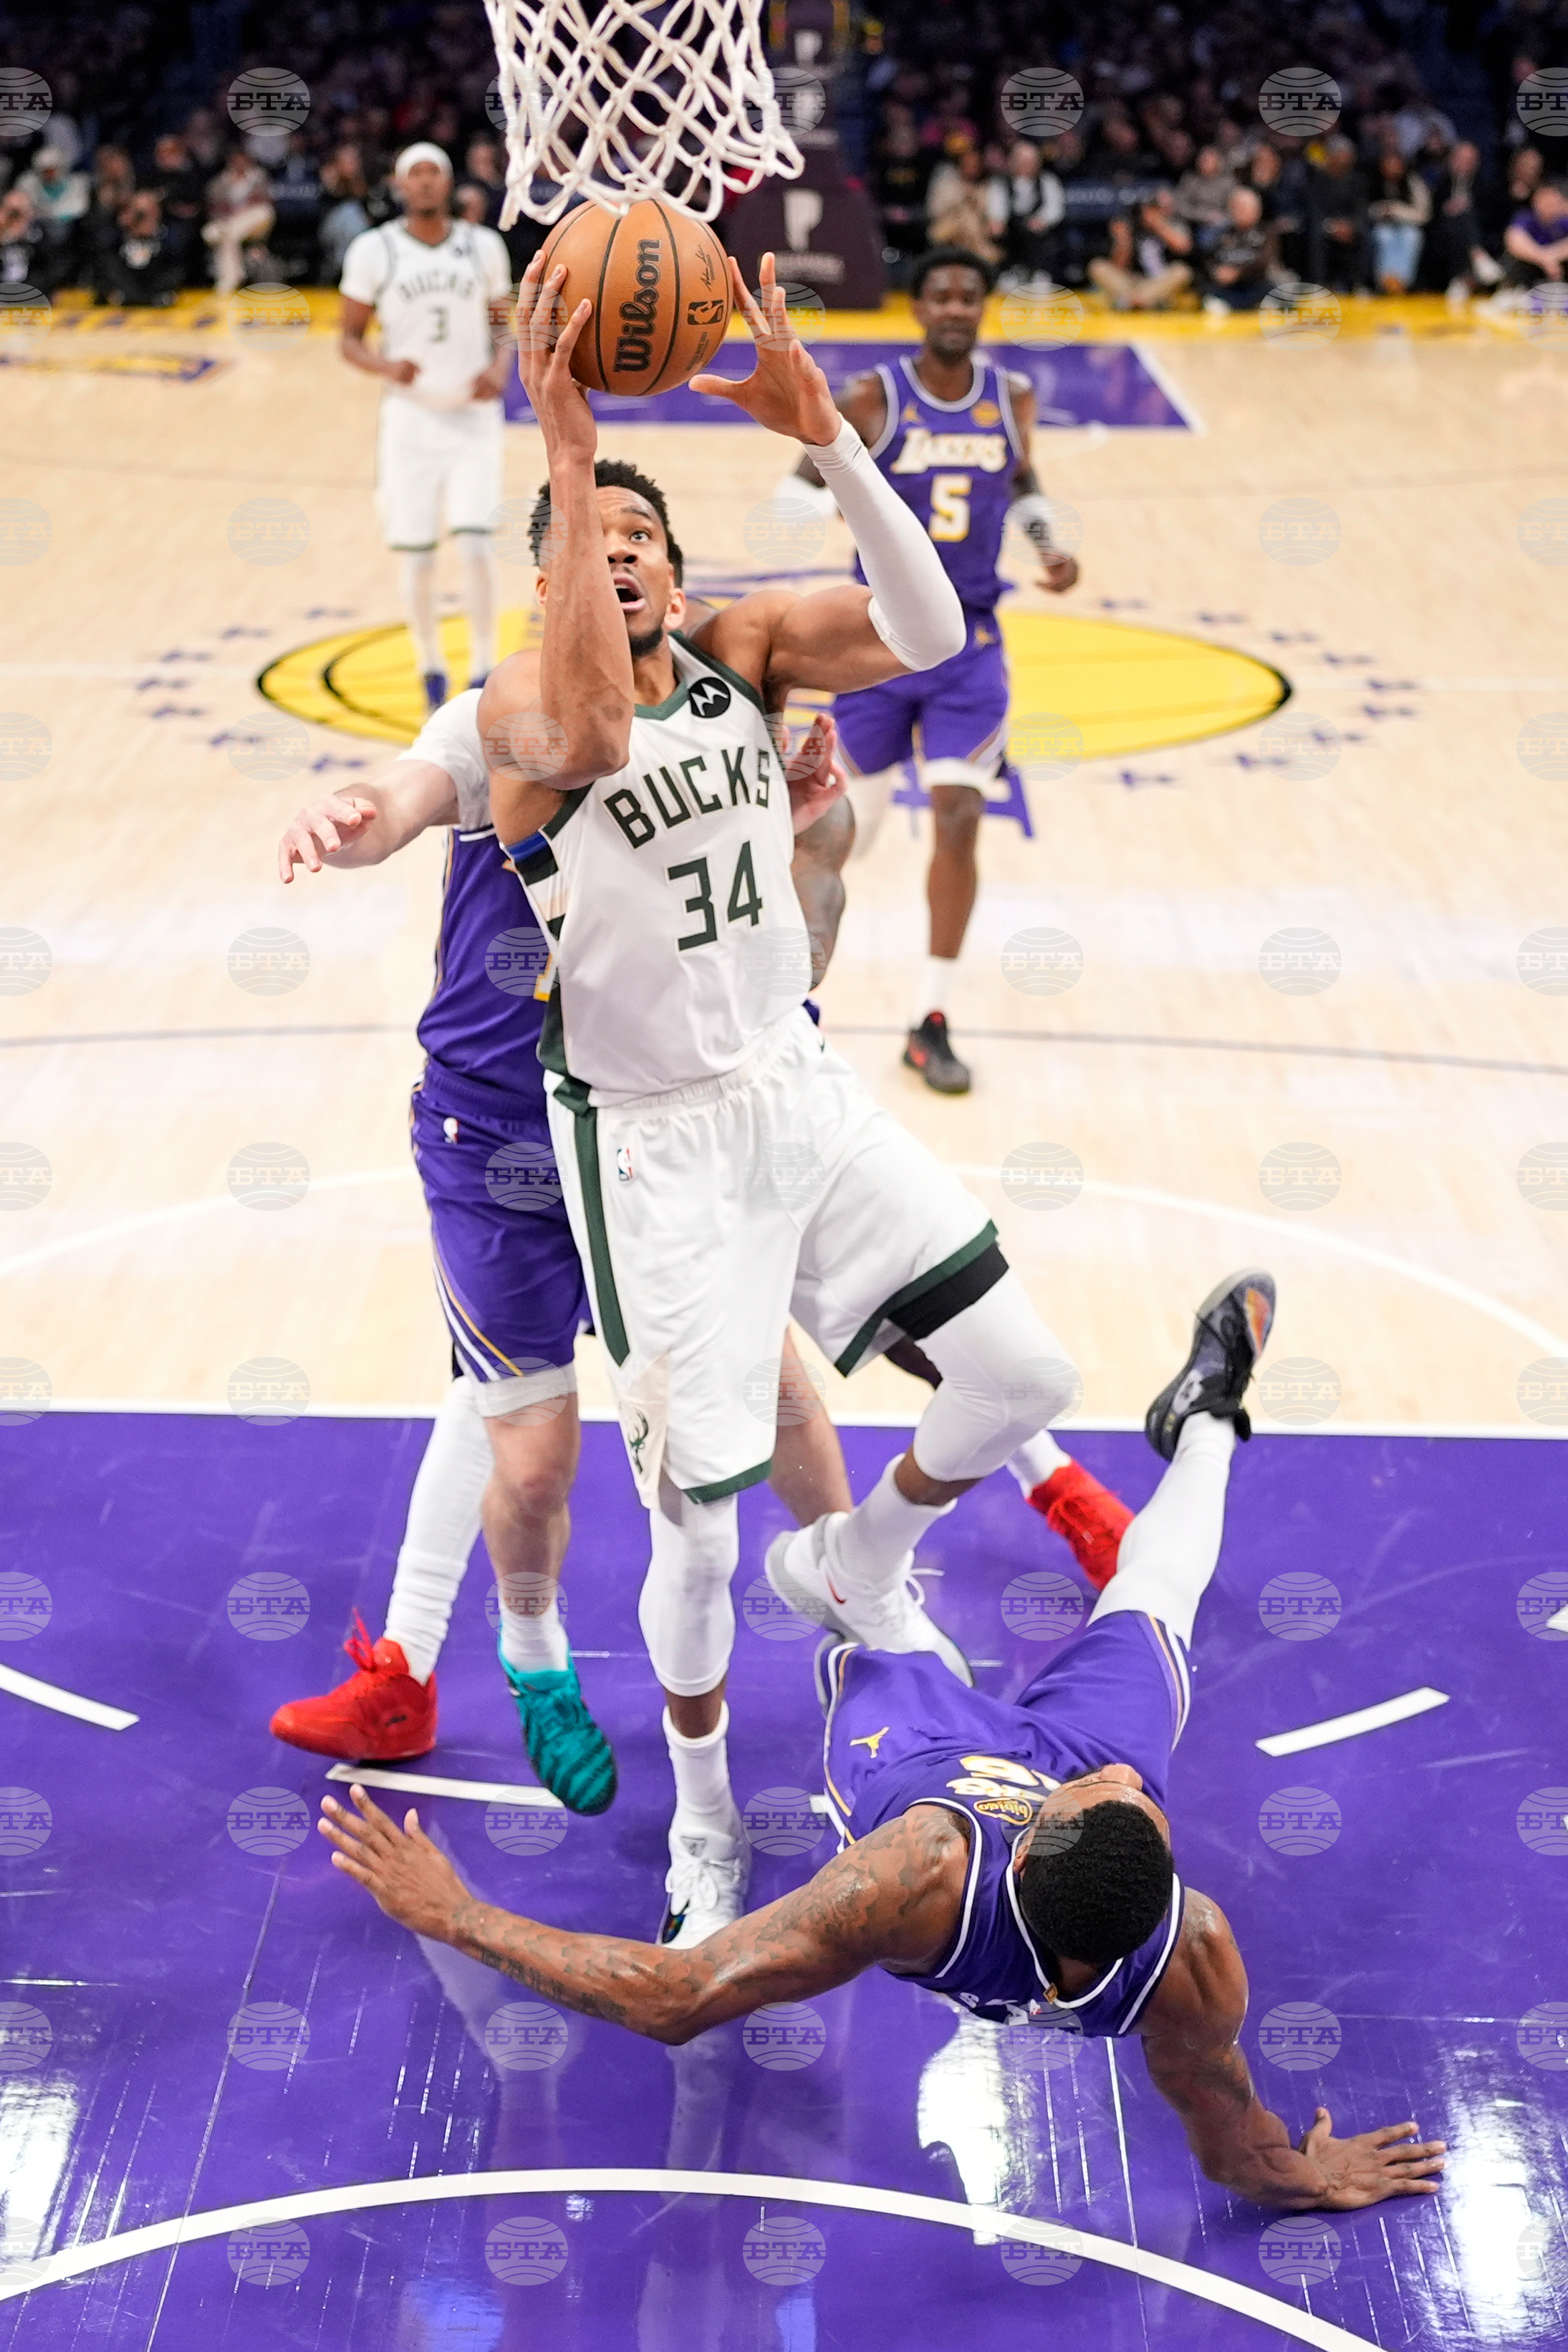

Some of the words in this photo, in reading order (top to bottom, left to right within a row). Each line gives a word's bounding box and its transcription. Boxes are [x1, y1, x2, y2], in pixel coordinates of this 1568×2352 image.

[612, 239, 662, 373] Wilson
[929, 474, 972, 542] 5
[602, 746, 770, 850] BUCKS
[667, 840, 763, 951] 34
